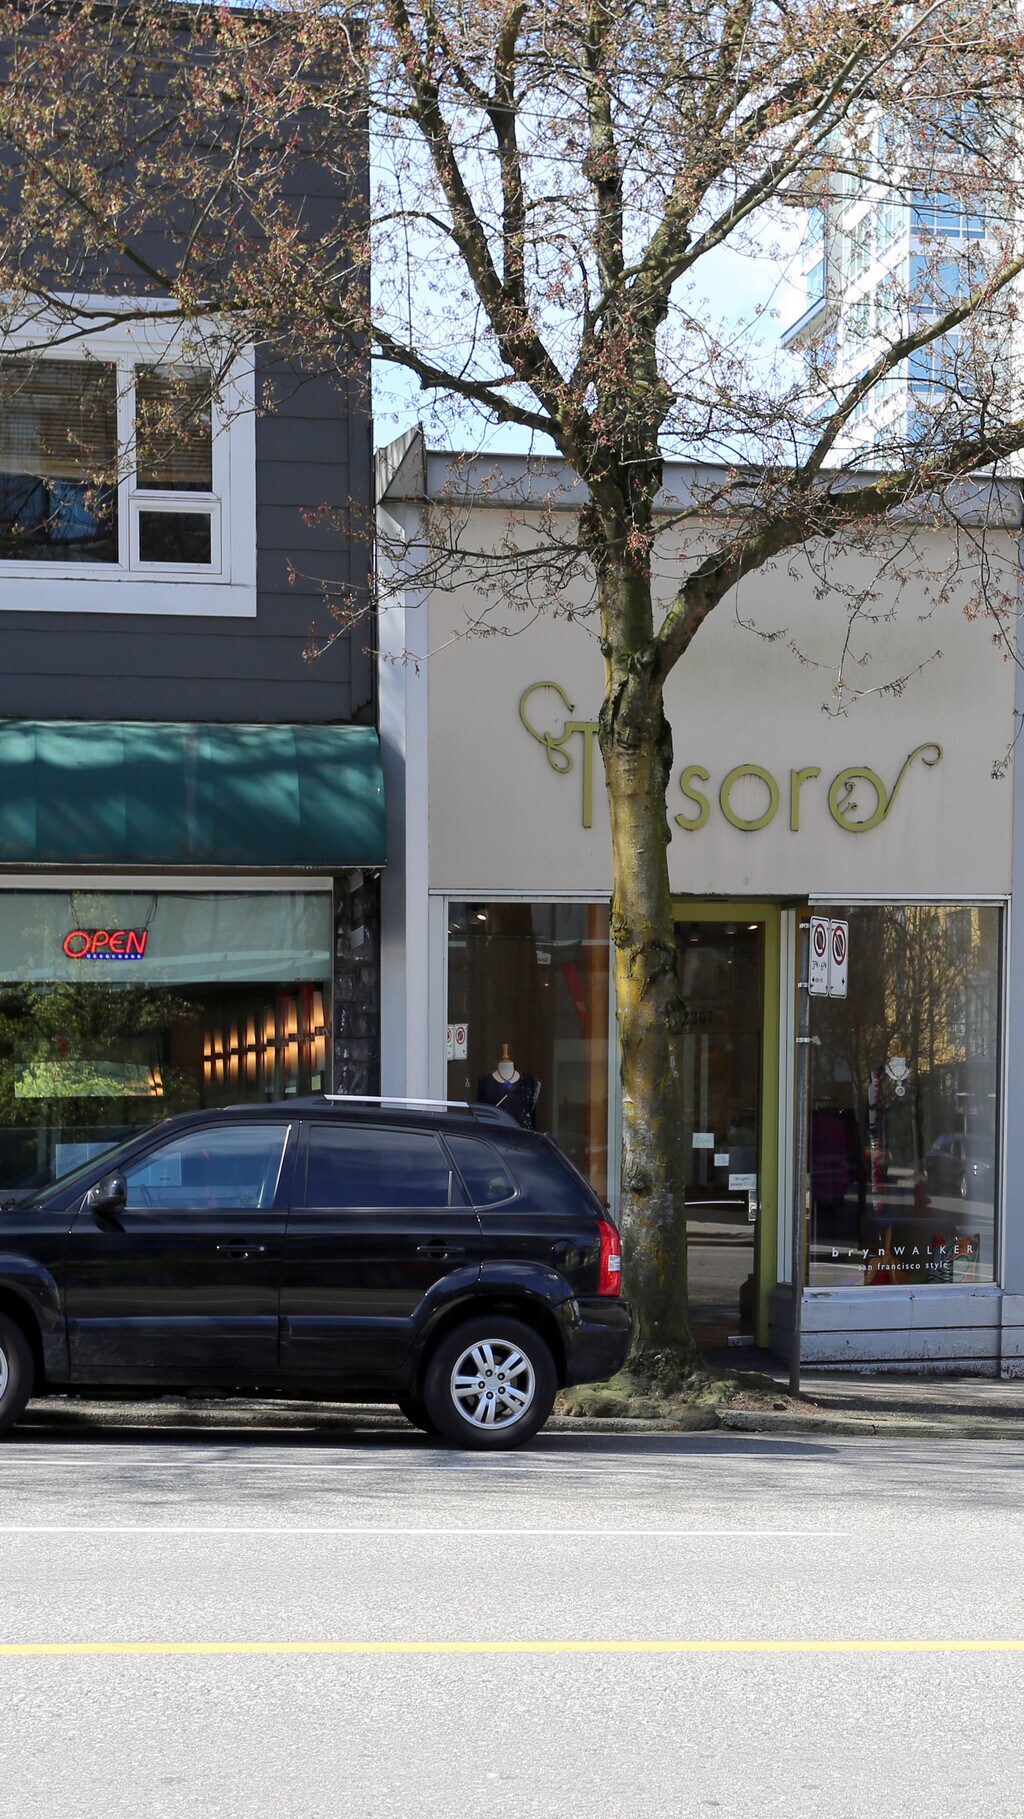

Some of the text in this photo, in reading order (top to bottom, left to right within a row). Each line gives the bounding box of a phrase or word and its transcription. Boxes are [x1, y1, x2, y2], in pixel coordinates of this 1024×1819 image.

[519, 681, 944, 832] Tsoro
[63, 930, 149, 959] OPEN
[857, 1261, 948, 1271] san francisco style
